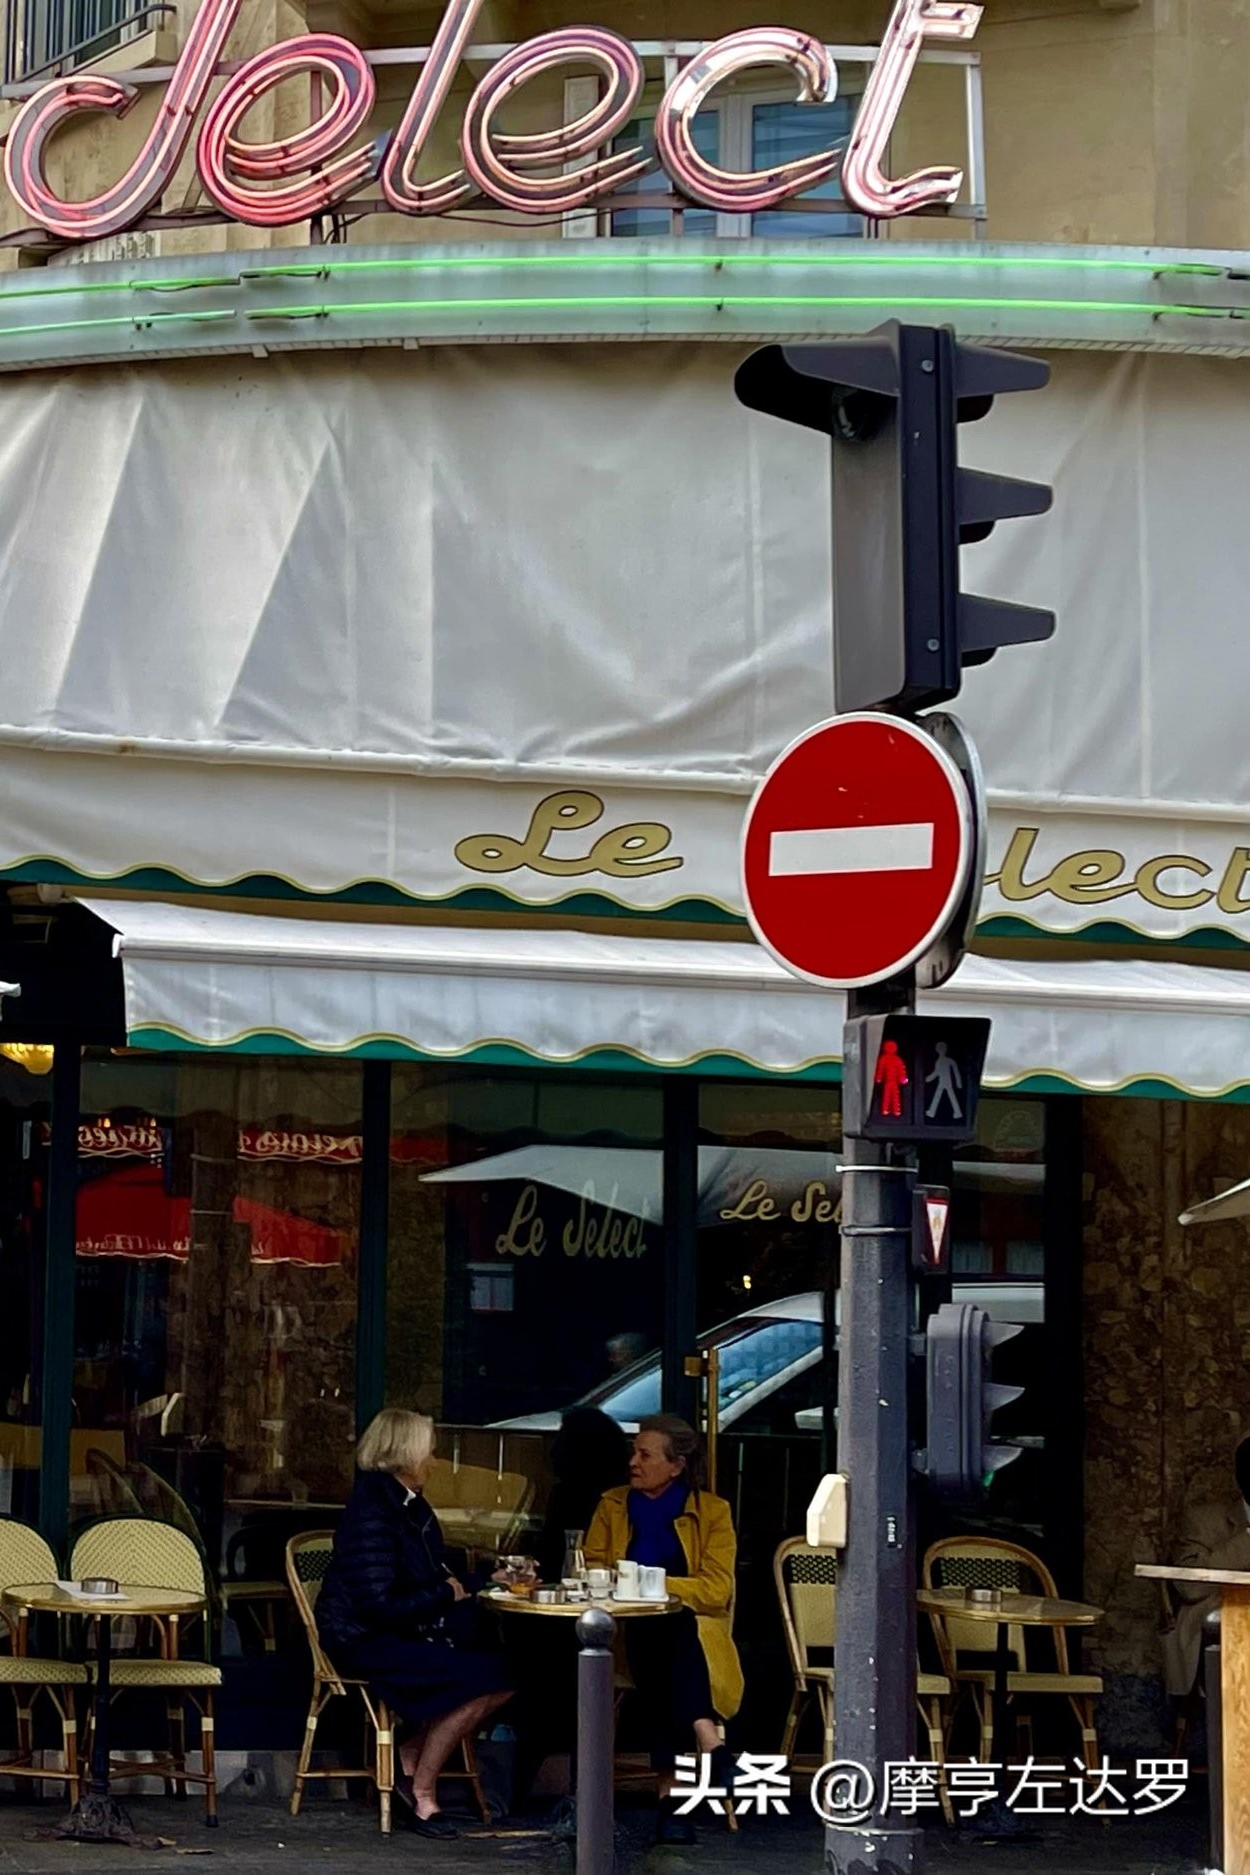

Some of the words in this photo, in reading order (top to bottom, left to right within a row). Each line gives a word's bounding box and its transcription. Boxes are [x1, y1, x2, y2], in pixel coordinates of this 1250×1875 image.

[4, 0, 985, 237] Select
[454, 789, 684, 878] Le
[983, 827, 1250, 914] lect
[495, 1184, 547, 1257] Le
[562, 1179, 647, 1258] Select
[719, 1180, 782, 1221] Le
